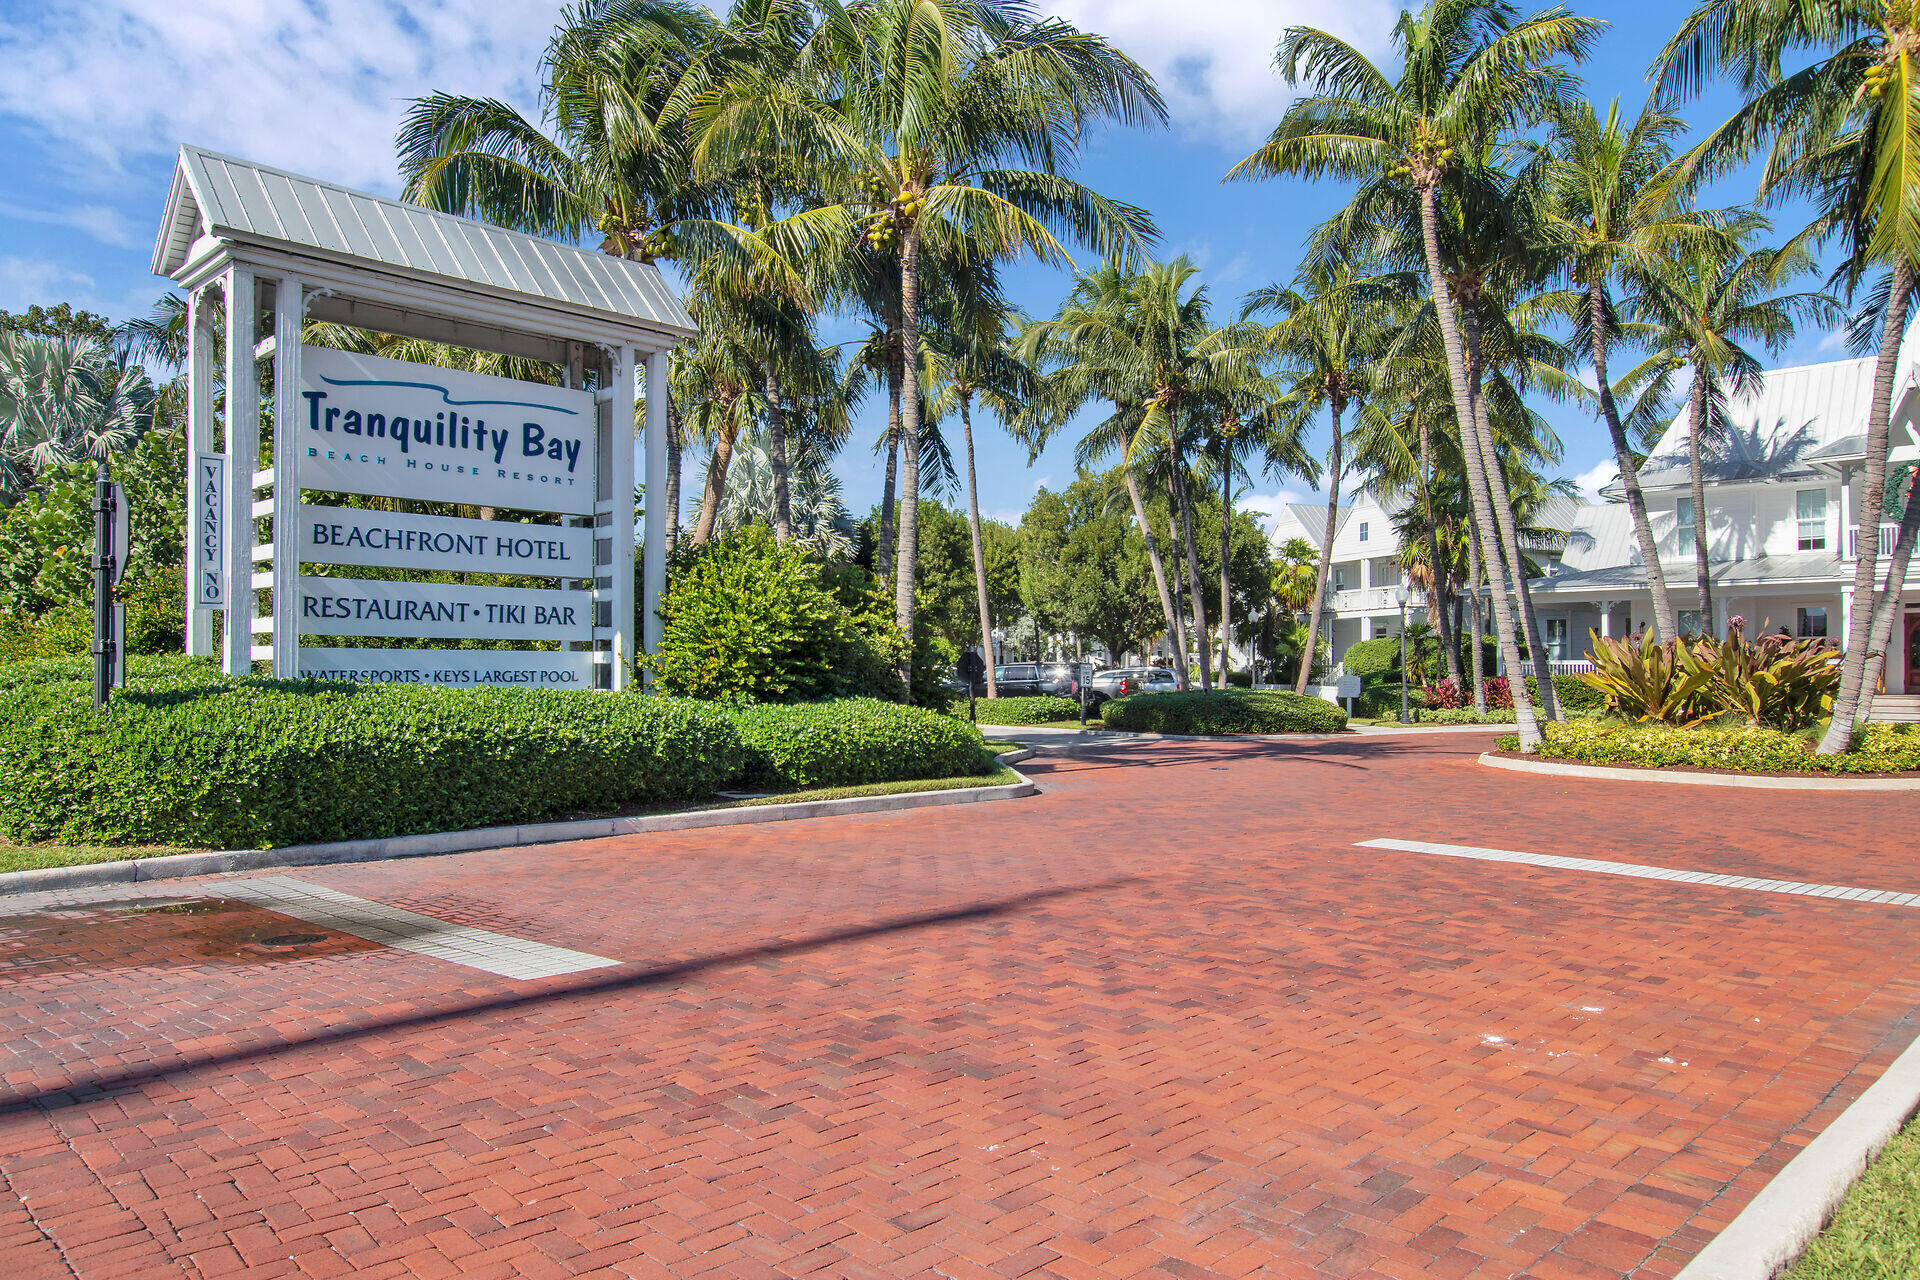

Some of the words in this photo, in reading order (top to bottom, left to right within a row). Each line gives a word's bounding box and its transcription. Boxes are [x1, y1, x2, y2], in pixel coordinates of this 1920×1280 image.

[302, 391, 508, 464] Tranquility
[522, 423, 581, 472] Bay
[307, 447, 387, 465] BEACH
[407, 459, 480, 475] HOUSE
[498, 469, 575, 486] RESORT
[204, 466, 218, 562] VACANCY
[313, 523, 488, 555] BEACHFRONT
[496, 538, 571, 561] HOTEL
[205, 572, 219, 599] NO
[303, 596, 470, 622] RESTAURANT
[485, 604, 526, 624] TIKI
[534, 606, 576, 626] BAR
[300, 669, 421, 684] WATERSPORTS
[433, 670, 471, 683] KEYS
[474, 670, 537, 683] LARGEST
[540, 670, 579, 682] POOL
[1082, 675, 1091, 685] 15
